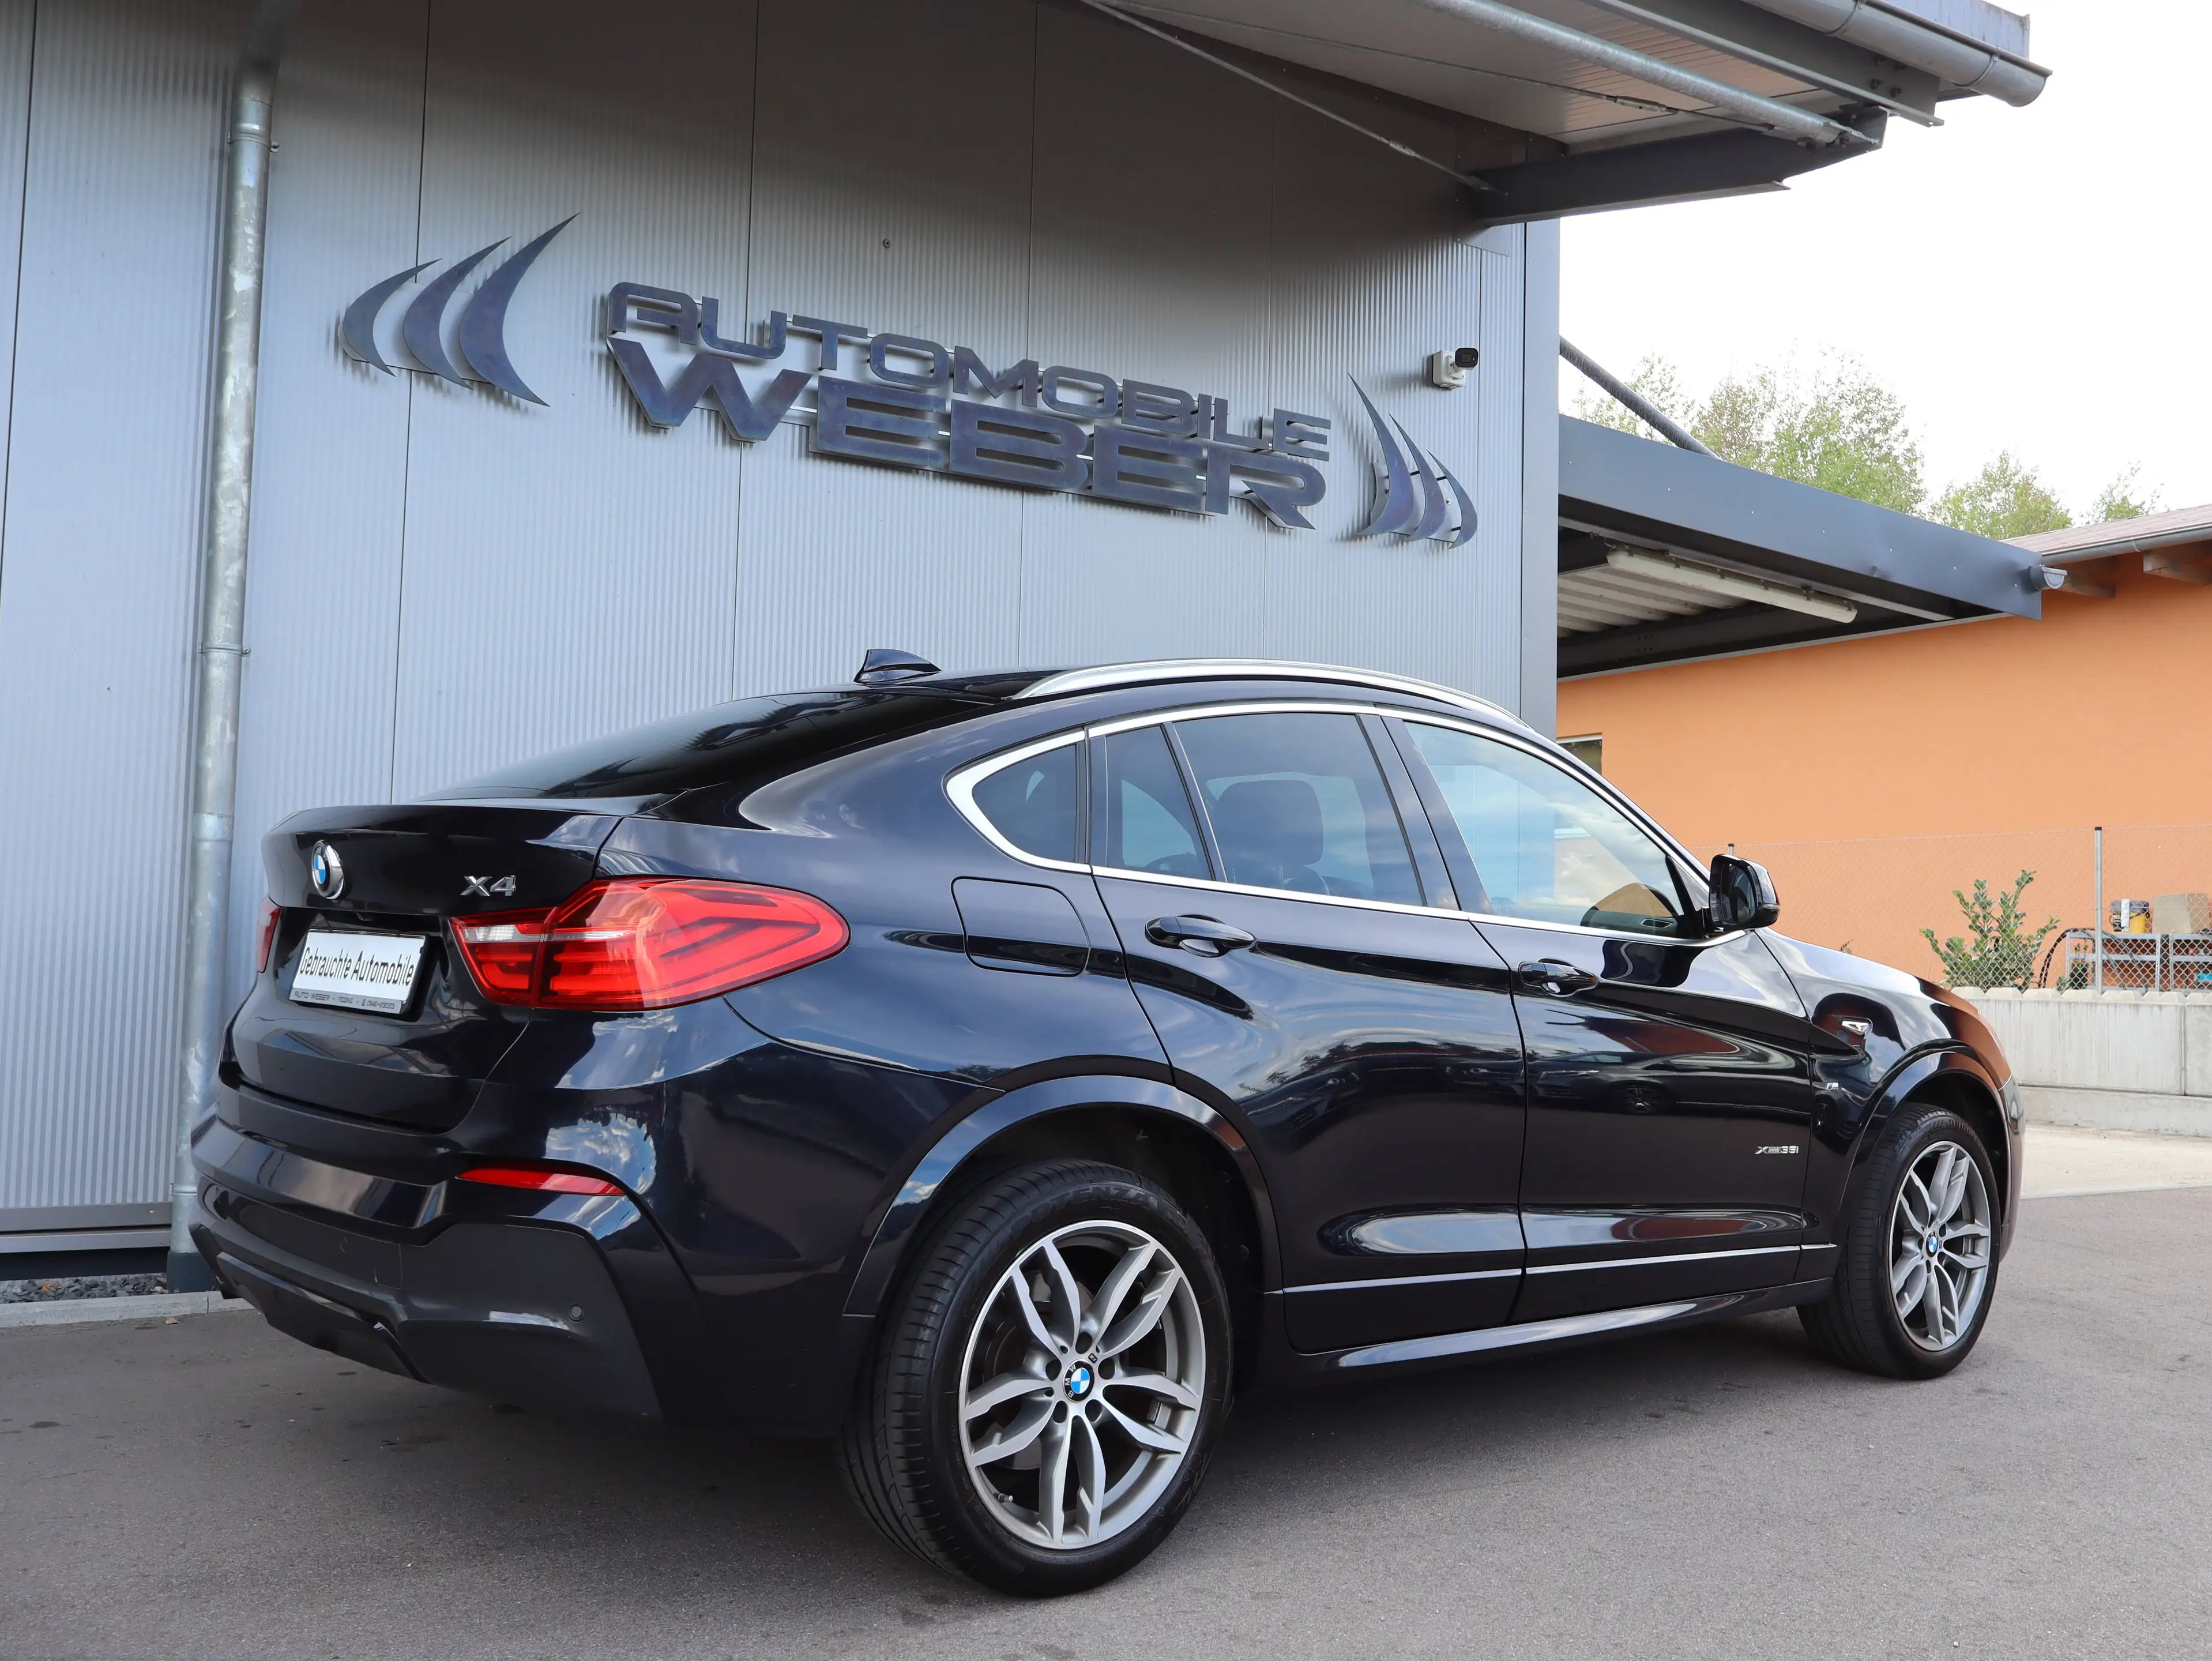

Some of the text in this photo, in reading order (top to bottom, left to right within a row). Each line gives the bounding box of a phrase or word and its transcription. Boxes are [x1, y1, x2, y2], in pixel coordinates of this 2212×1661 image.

[608, 282, 1331, 462] AUTOMOBILE
[607, 336, 1326, 530] WEBER
[460, 875, 516, 896] X4
[300, 946, 414, 987] Gebrauchte Automobile
[294, 991, 309, 999] AUTO
[1065, 1363, 1077, 1398] BMW
